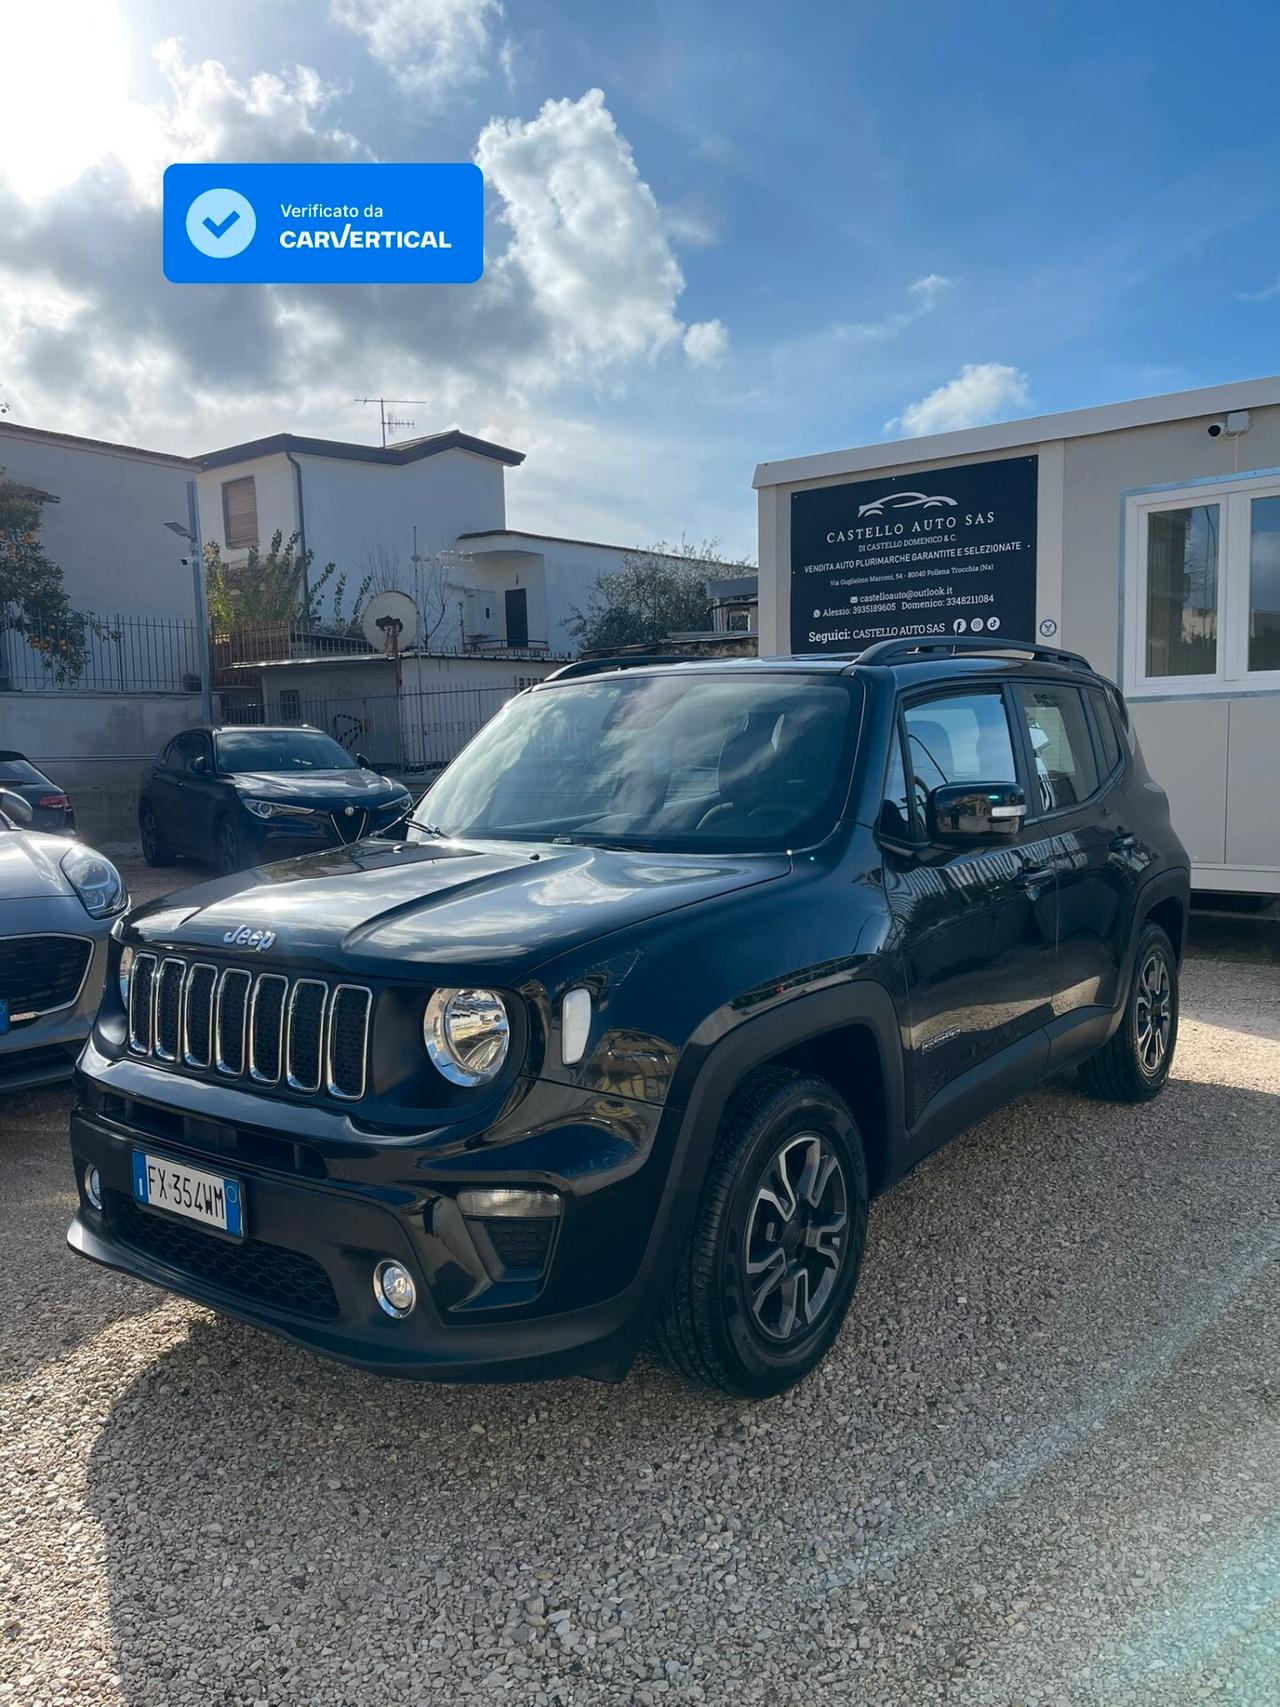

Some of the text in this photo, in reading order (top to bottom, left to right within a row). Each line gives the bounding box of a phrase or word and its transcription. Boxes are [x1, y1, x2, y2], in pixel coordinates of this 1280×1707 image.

[827, 511, 995, 543] CASTELLO AUTO SAS
[866, 540, 903, 552] CASTELLO
[903, 535, 943, 547] DOMENICO
[943, 534, 949, 542] &
[804, 541, 1022, 574] VENDITA AUTO PLURIMARCHE GARANTITE E SELEZIONATE
[927, 567, 950, 577] Pollena
[951, 564, 979, 574] Trocchia
[980, 562, 995, 573] (Na)
[946, 593, 995, 607] 3348211084
[808, 622, 946, 644] Seguici: CASTELLO AUTO SAS
[223, 924, 277, 953] Jeep
